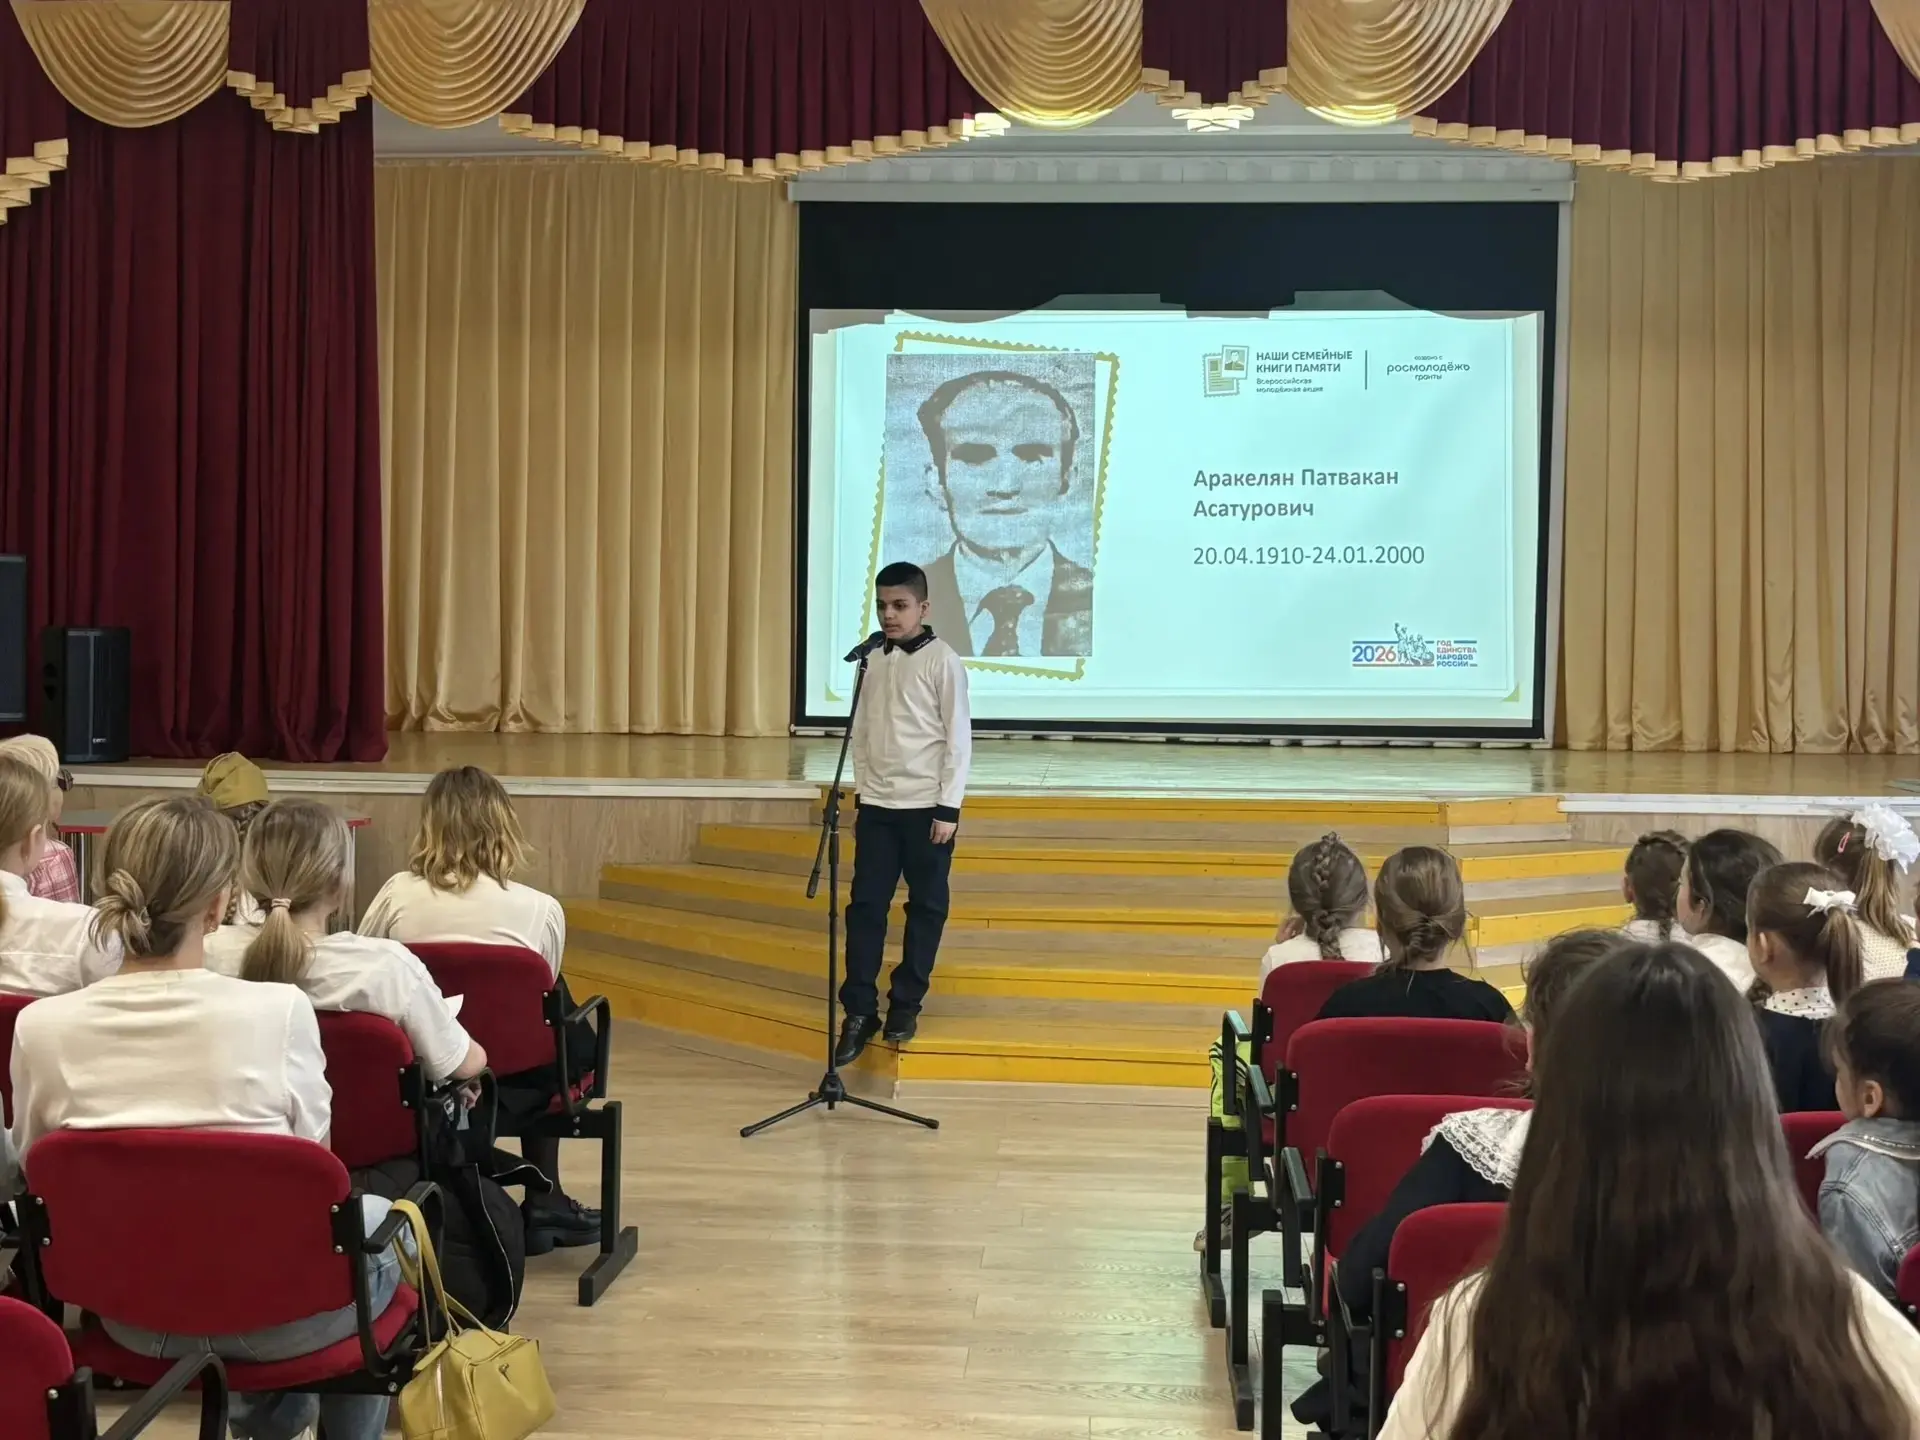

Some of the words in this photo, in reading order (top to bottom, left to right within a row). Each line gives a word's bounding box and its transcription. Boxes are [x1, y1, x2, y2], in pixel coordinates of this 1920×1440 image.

[1256, 352, 1289, 361] НАШИ
[1292, 348, 1353, 360] СЕМЕЙНЫЕ
[1256, 364, 1292, 373] КНИГИ
[1295, 363, 1341, 373] ПАМЯТИ
[1387, 361, 1470, 375] росмолодёжь
[1256, 377, 1312, 386] Всероссийская
[1193, 470, 1294, 491] Аракелян
[1302, 469, 1399, 486] Патвакан
[1193, 500, 1314, 521] Асатурович
[1193, 546, 1425, 565] 20.04.1910-24.01.2000
[1352, 645, 1396, 662] 2026
